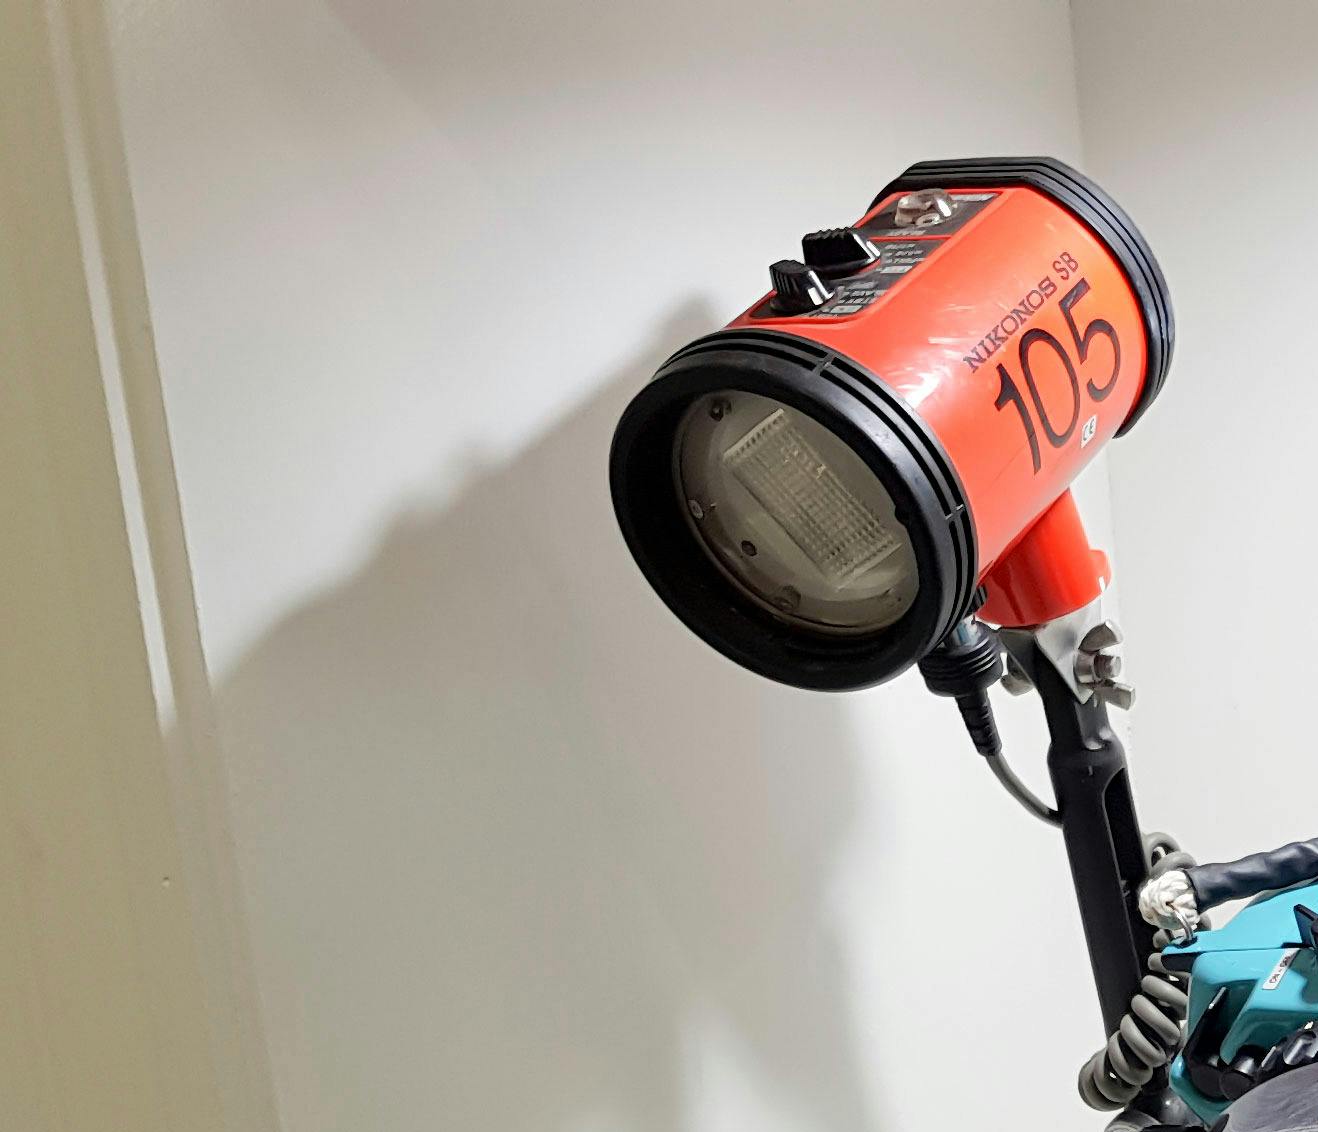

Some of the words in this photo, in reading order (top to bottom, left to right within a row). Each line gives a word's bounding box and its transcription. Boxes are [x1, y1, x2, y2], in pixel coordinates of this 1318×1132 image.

[962, 275, 1058, 374] NIKONOS
[1052, 251, 1080, 281] SB
[994, 277, 1121, 476] 105
